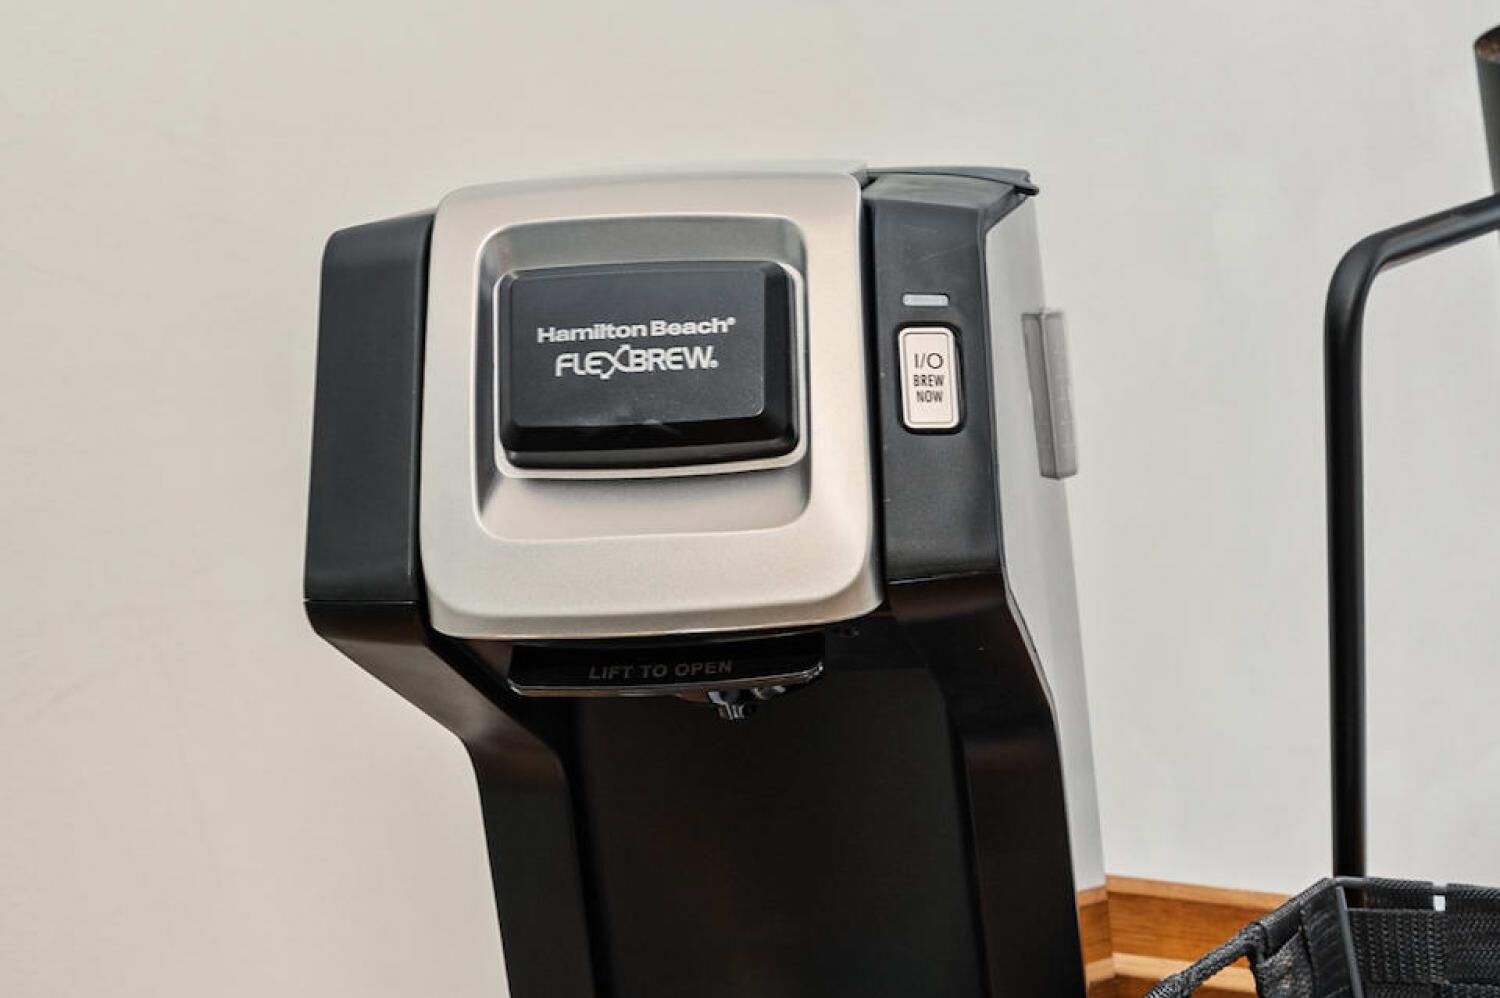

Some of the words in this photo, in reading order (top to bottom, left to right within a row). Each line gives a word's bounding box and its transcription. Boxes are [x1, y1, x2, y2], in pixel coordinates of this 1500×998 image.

[536, 322, 648, 344] Hamilton
[913, 374, 945, 387] BREW
[916, 389, 944, 403] NOW
[588, 664, 634, 681] LIFT
[638, 663, 669, 679] TO
[673, 660, 734, 678] OPEN
